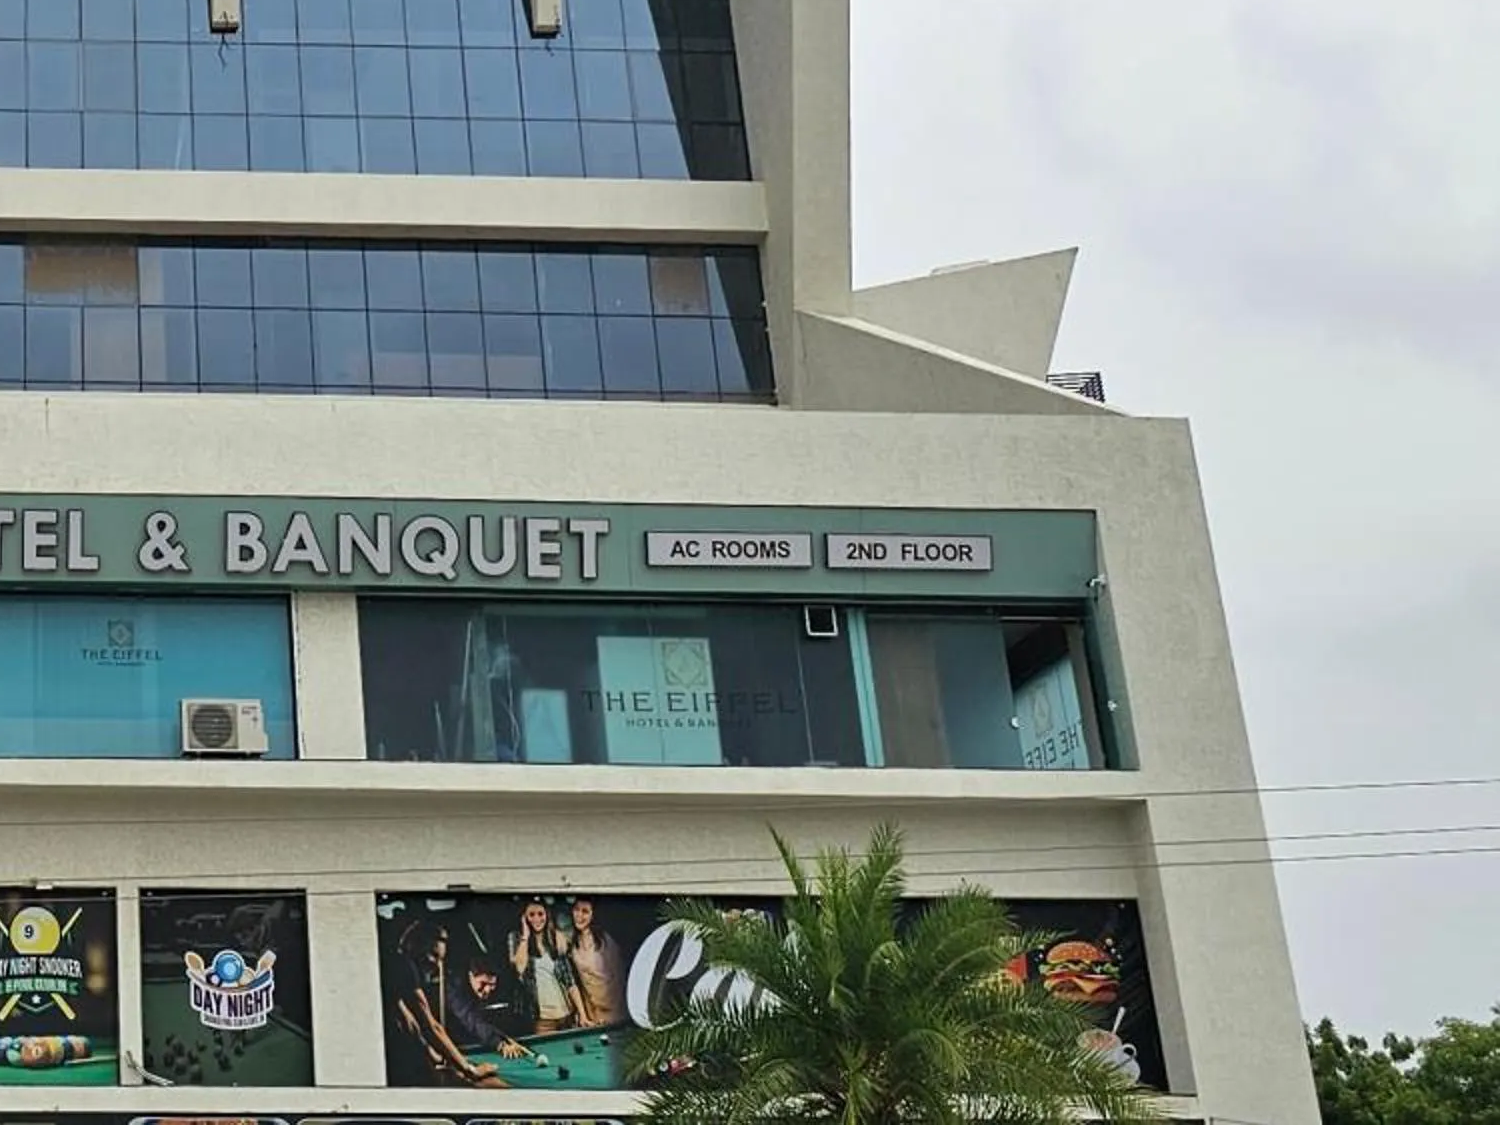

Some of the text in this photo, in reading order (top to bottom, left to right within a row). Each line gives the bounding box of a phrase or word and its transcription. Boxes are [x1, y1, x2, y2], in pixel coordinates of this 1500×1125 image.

[137, 510, 192, 573] &
[225, 511, 610, 581] BANQUET
[669, 540, 791, 560] AC ROOMS
[846, 542, 973, 563] 2ND FLOOR
[580, 690, 799, 715] THE EIFFEL
[193, 982, 273, 1018] DAY NIGHT
